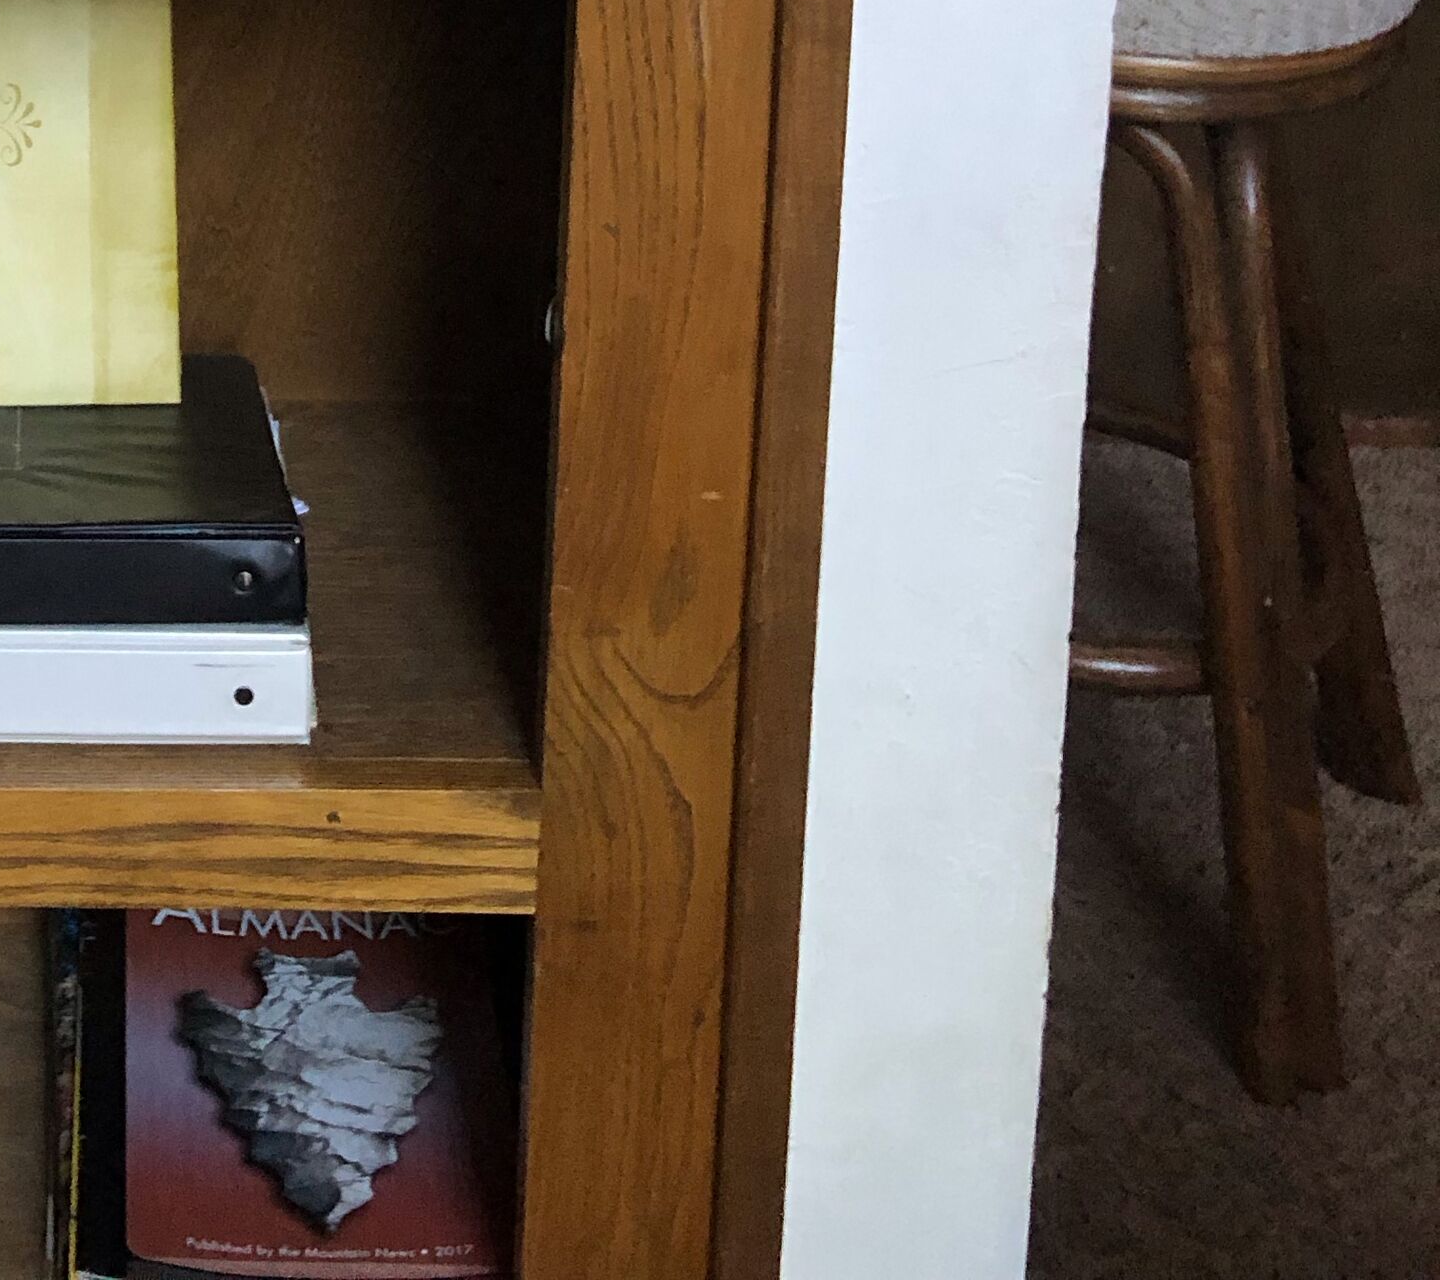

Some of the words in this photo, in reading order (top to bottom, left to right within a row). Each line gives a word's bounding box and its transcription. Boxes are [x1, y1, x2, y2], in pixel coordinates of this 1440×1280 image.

[185, 1237, 253, 1257] Published
[256, 1243, 275, 1260] by
[278, 1243, 302, 1258] the
[374, 1243, 418, 1259] News
[436, 1243, 476, 1259] 2017
